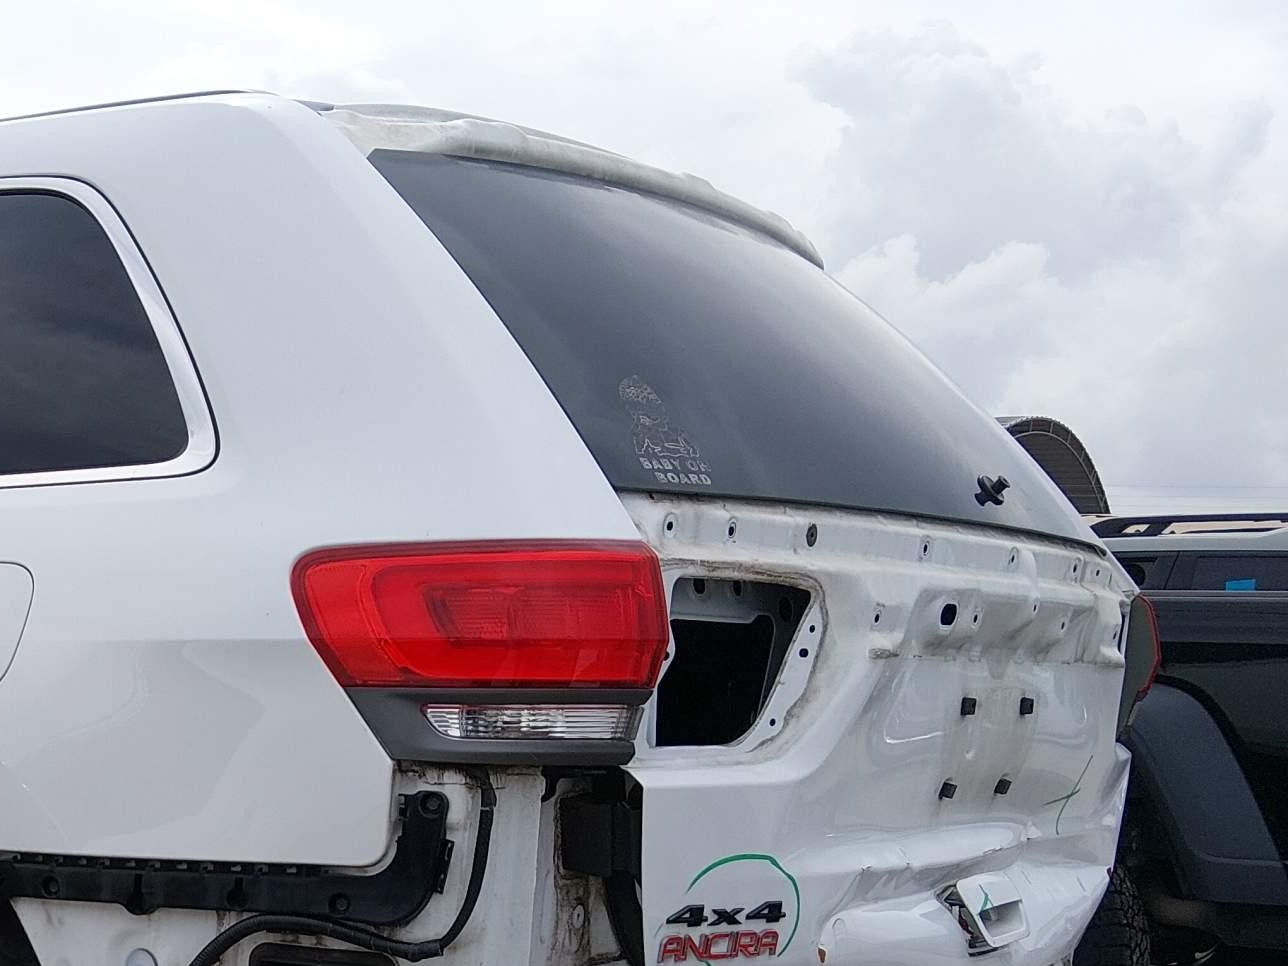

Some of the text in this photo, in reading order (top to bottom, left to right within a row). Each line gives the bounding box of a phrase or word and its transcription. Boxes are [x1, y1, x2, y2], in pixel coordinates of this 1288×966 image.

[639, 457, 681, 470] BABY
[654, 471, 712, 485] BOARD
[665, 900, 787, 928] 4x4
[656, 928, 780, 964] ANCIRA
